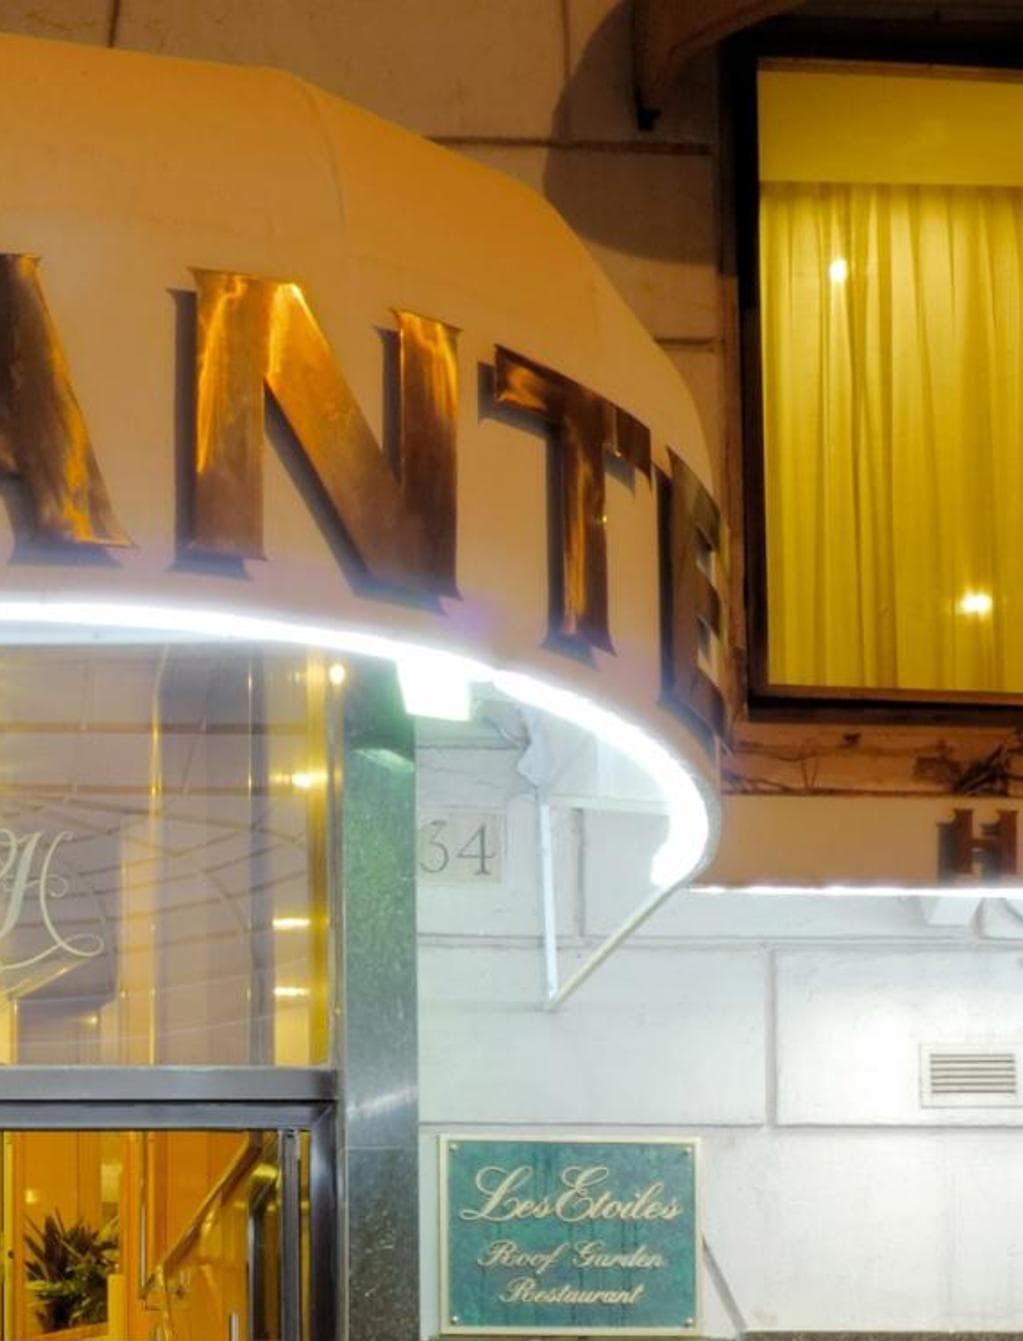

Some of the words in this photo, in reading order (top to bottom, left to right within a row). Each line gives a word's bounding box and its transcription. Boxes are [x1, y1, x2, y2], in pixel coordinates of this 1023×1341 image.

[419, 819, 497, 876] 34
[460, 1165, 555, 1221] Les
[478, 1240, 568, 1275] Roof
[572, 1240, 664, 1268] Garden
[500, 1277, 645, 1304] Restaurant
